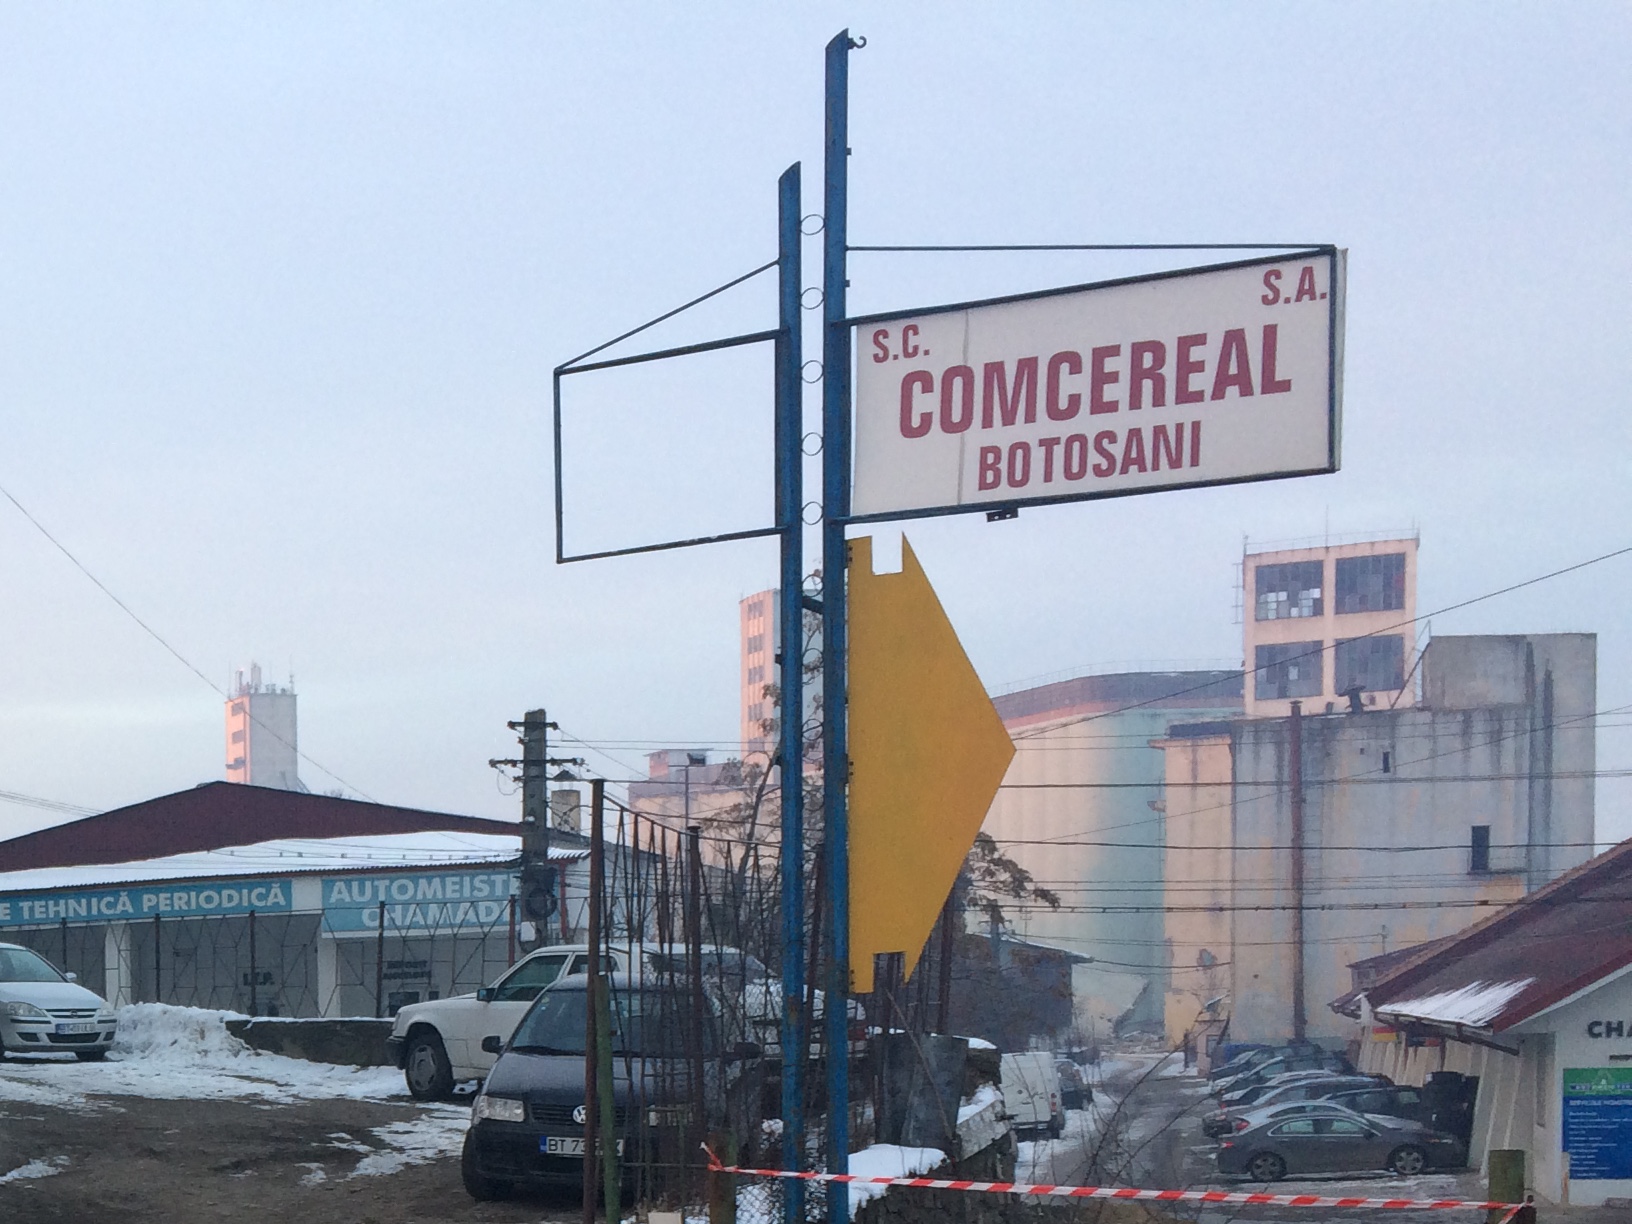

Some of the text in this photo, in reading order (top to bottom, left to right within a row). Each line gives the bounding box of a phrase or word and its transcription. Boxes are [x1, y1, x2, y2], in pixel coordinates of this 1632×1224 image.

[1261, 266, 1328, 306] S.A.
[872, 324, 930, 364] S.C.
[899, 323, 1292, 439] COMCEREAL
[978, 420, 1202, 491] BOTOSANI
[18, 893, 134, 921] TEHNICĂ
[142, 882, 286, 912] PERIODICĂ
[329, 872, 521, 904] AUTOMEISTE
[548, 1138, 566, 1152] BT
